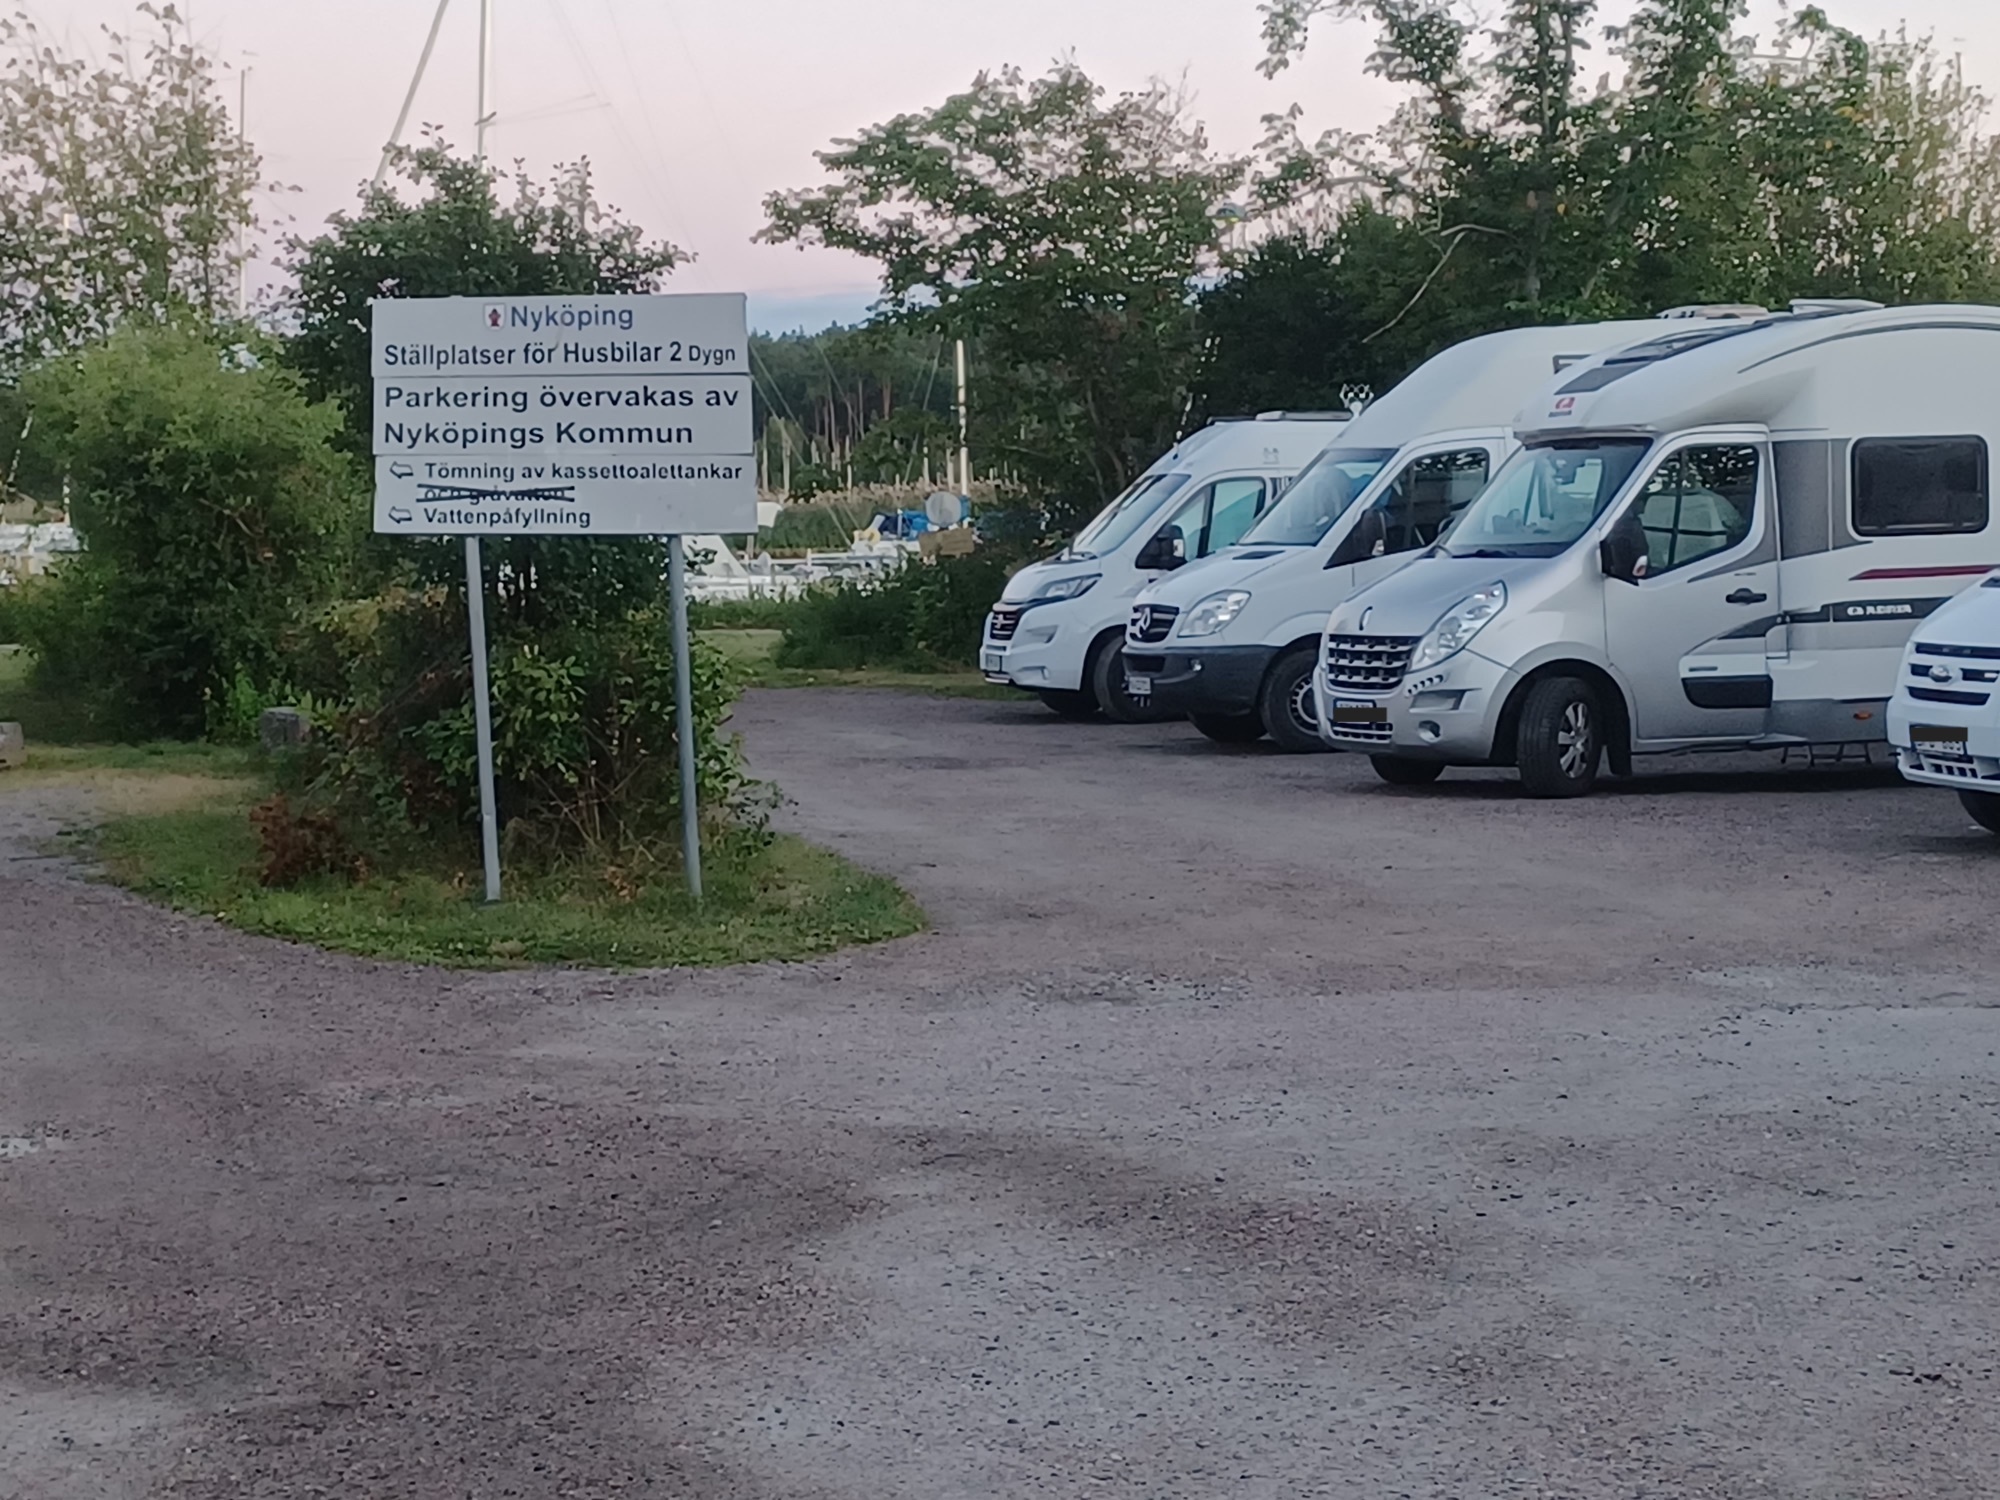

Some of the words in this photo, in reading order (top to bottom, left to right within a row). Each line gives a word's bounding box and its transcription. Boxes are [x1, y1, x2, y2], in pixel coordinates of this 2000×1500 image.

[511, 305, 633, 331] Nyköping
[385, 344, 516, 369] Ställplatser
[524, 343, 555, 364] för
[564, 342, 662, 363] Husbilar
[669, 342, 682, 361] 2
[689, 346, 735, 365] Dygn
[385, 386, 528, 412] Parkering
[540, 386, 694, 407] övervakas
[705, 390, 739, 406] av
[385, 422, 545, 449] Nyköpings
[556, 422, 693, 444] Kommun
[425, 463, 514, 482] Tömning
[521, 466, 544, 478] av
[552, 463, 742, 479] kassettoalettankar
[424, 508, 591, 528] Vattenpåfyllning
